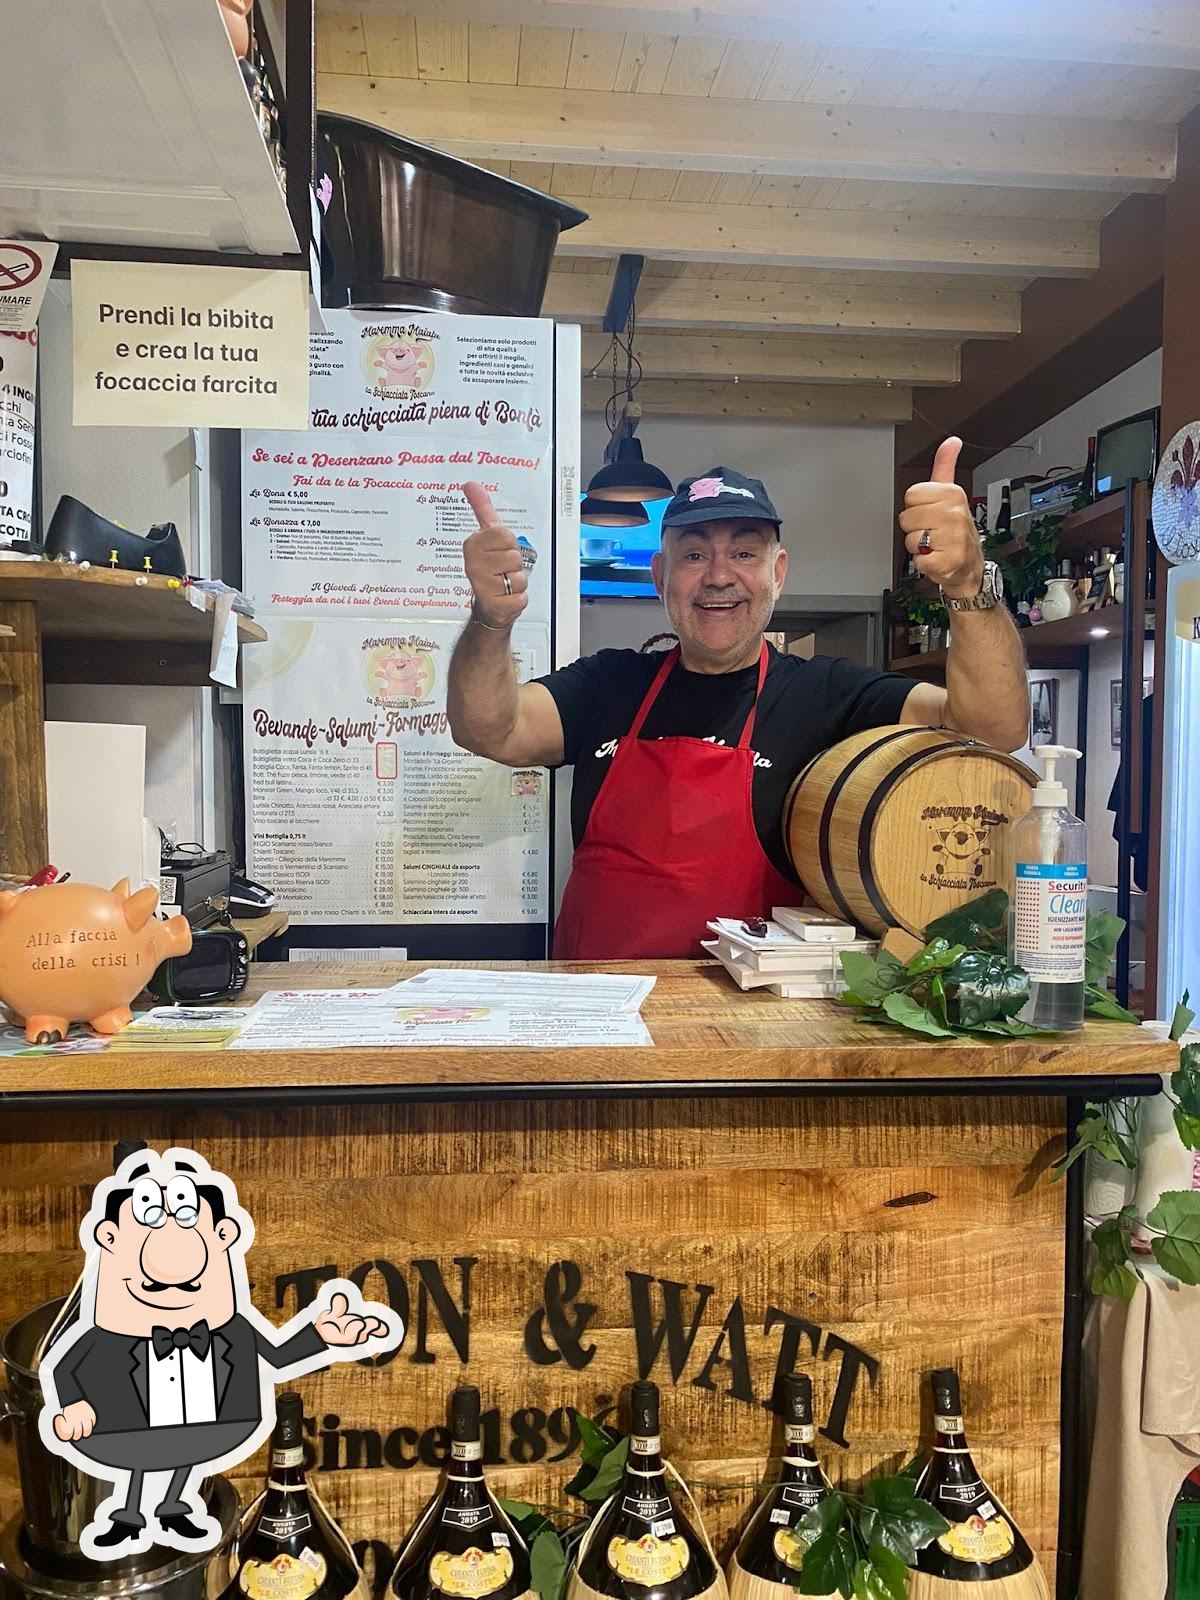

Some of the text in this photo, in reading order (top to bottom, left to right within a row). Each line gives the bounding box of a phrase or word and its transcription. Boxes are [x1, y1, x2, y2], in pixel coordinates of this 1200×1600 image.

[99, 303, 274, 330] Prendi la bibita
[360, 323, 441, 342] Maremma Maiala
[456, 336, 497, 344] Selezioniamo
[115, 341, 258, 362] e crea la tua
[459, 360, 492, 368] ingredienti
[95, 371, 278, 394] focaccia farcita
[372, 387, 408, 401] Schiacciata
[311, 400, 542, 433] tua schiacciata piena di Bontà
[252, 447, 541, 470] Se sei a Desenzano Passa dal Toscano!
[293, 474, 314, 487] Fai
[316, 476, 332, 486] da
[335, 477, 345, 487] te
[348, 477, 360, 488] la
[363, 477, 414, 490] Focaccia
[417, 482, 446, 491] come
[250, 488, 261, 498] La
[262, 488, 285, 498] Bona
[416, 495, 427, 504] La
[250, 517, 261, 526] La
[263, 517, 299, 526] Bonazza
[416, 538, 428, 546] La
[416, 564, 463, 573] Lampredotto
[323, 583, 357, 593] Giovedì
[359, 583, 407, 594] Apericena
[427, 586, 450, 596] Gran
[271, 594, 313, 605] Festeggia
[316, 595, 328, 603] da
[330, 595, 346, 604] noi
[353, 596, 371, 605] tuoi
[373, 597, 400, 605] Eventi
[403, 597, 461, 608] Compleanno,
[361, 634, 441, 653] Maremma Maiala
[374, 696, 409, 709] Schiacciata
[27, 929, 118, 948] Alla faccia
[32, 956, 77, 971] della
[92, 953, 127, 967] crisi
[524, 1259, 598, 1370] &
[625, 1270, 880, 1450] WATT
[801, 1497, 818, 1505] 2019
[959, 1491, 976, 1500] 2019
[461, 1516, 478, 1524] 2019
[274, 1526, 293, 1534] 2019
